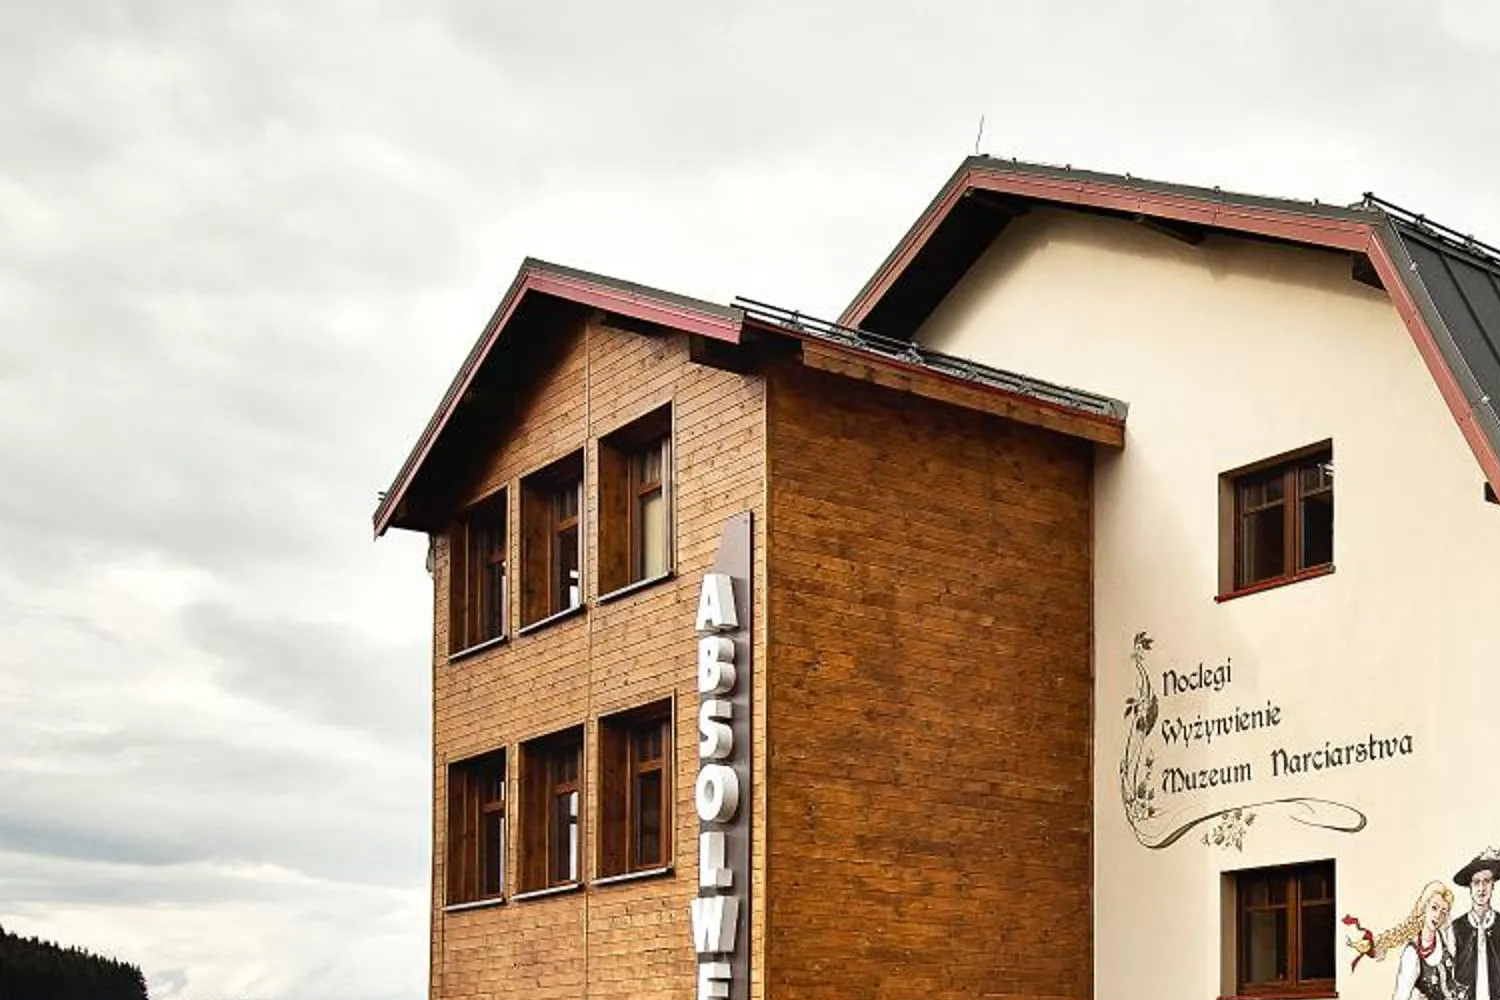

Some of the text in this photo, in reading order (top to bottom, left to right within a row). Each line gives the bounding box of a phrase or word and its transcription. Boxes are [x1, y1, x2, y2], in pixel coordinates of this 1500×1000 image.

[1162, 658, 1232, 696] Noclegi
[1161, 701, 1281, 746] Wyżywienie
[1162, 733, 1413, 793] Muzeum Narciarstwa
